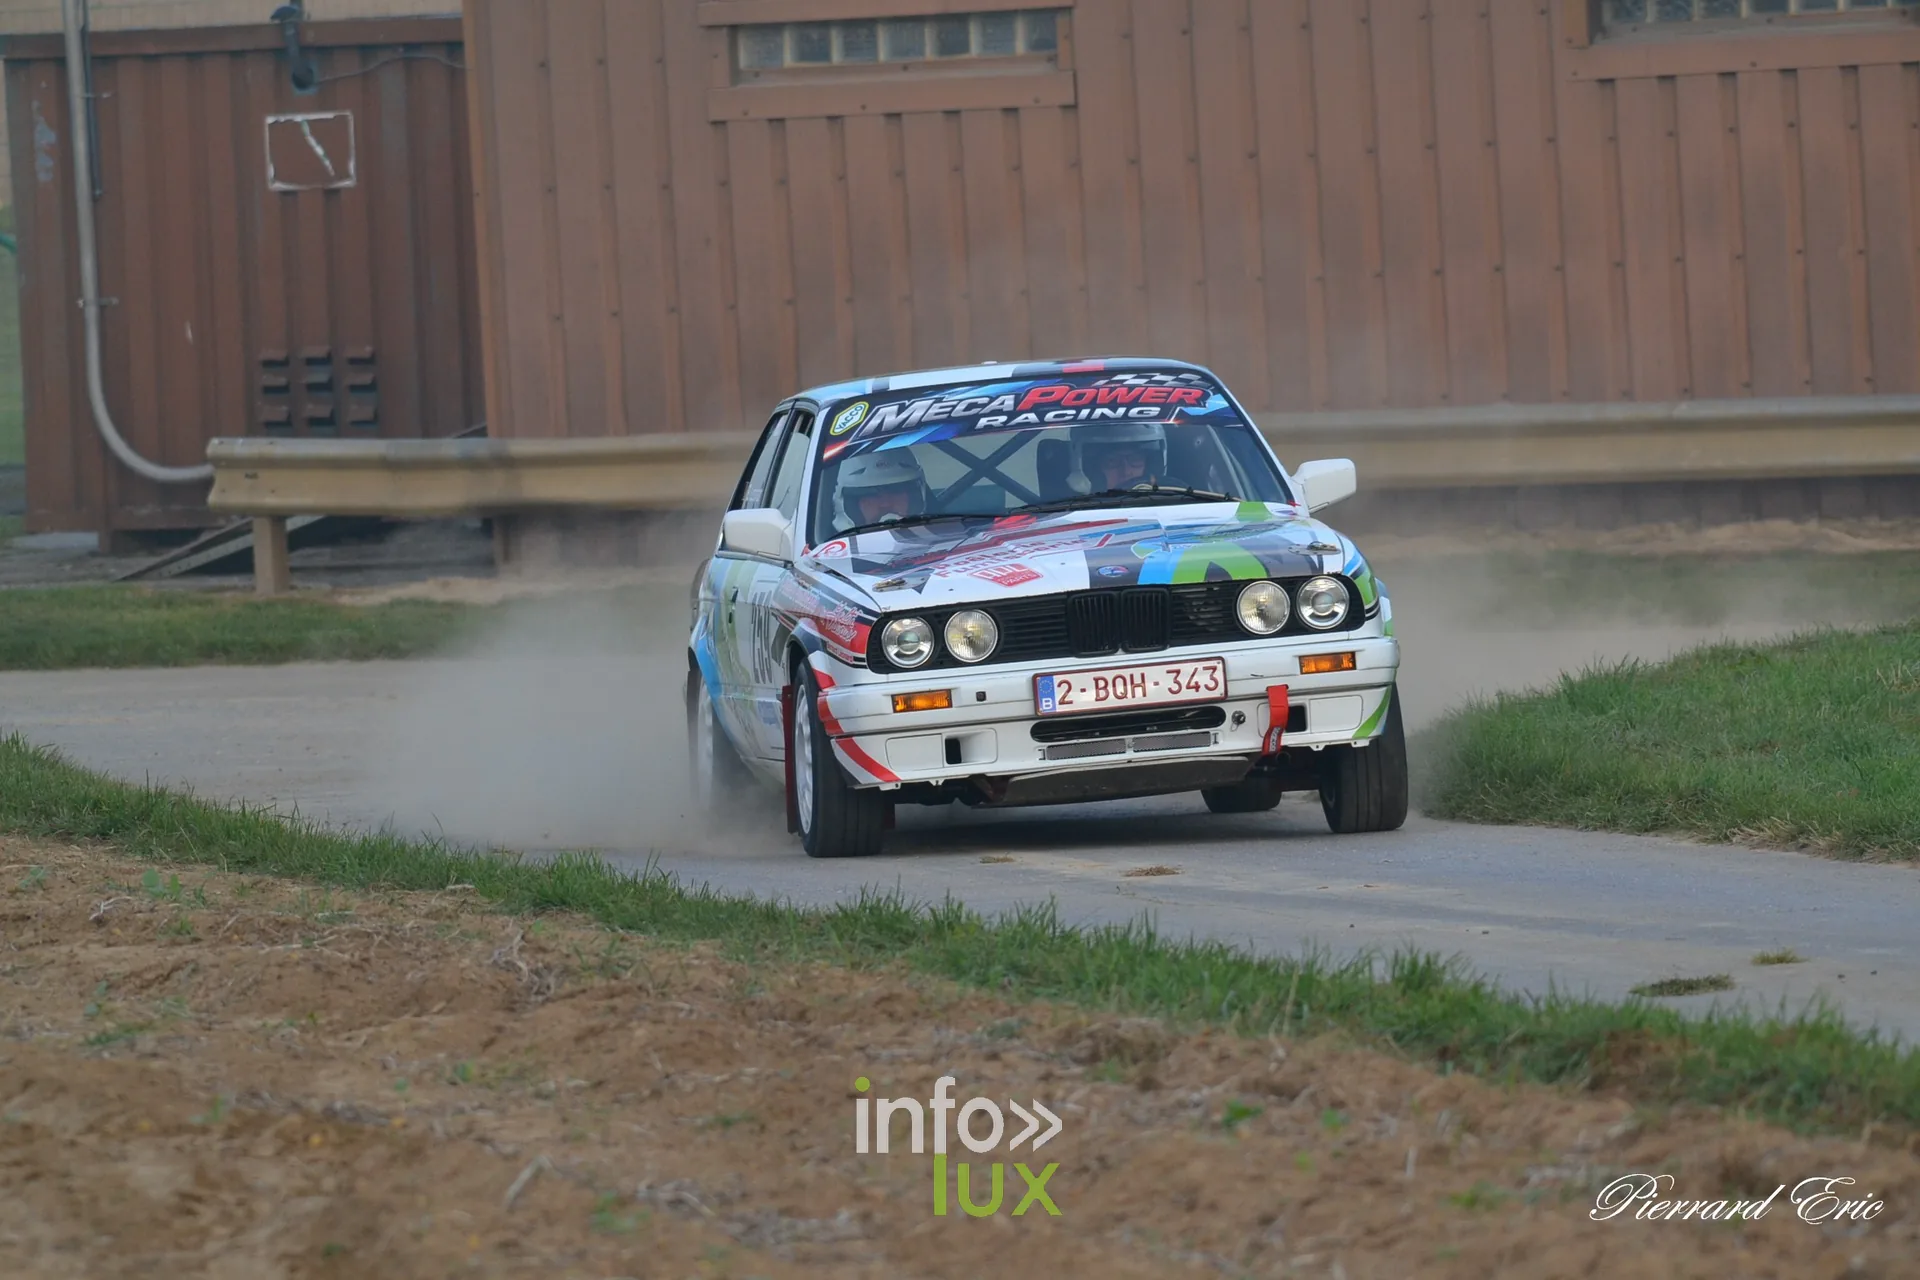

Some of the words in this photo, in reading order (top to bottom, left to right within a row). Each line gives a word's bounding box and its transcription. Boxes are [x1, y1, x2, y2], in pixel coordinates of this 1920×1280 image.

[1016, 385, 1204, 411] POWER
[835, 405, 864, 432] YACCO
[974, 406, 1161, 430] RACING
[1057, 666, 1220, 706] 2-BQH-343
[1042, 697, 1053, 710] B
